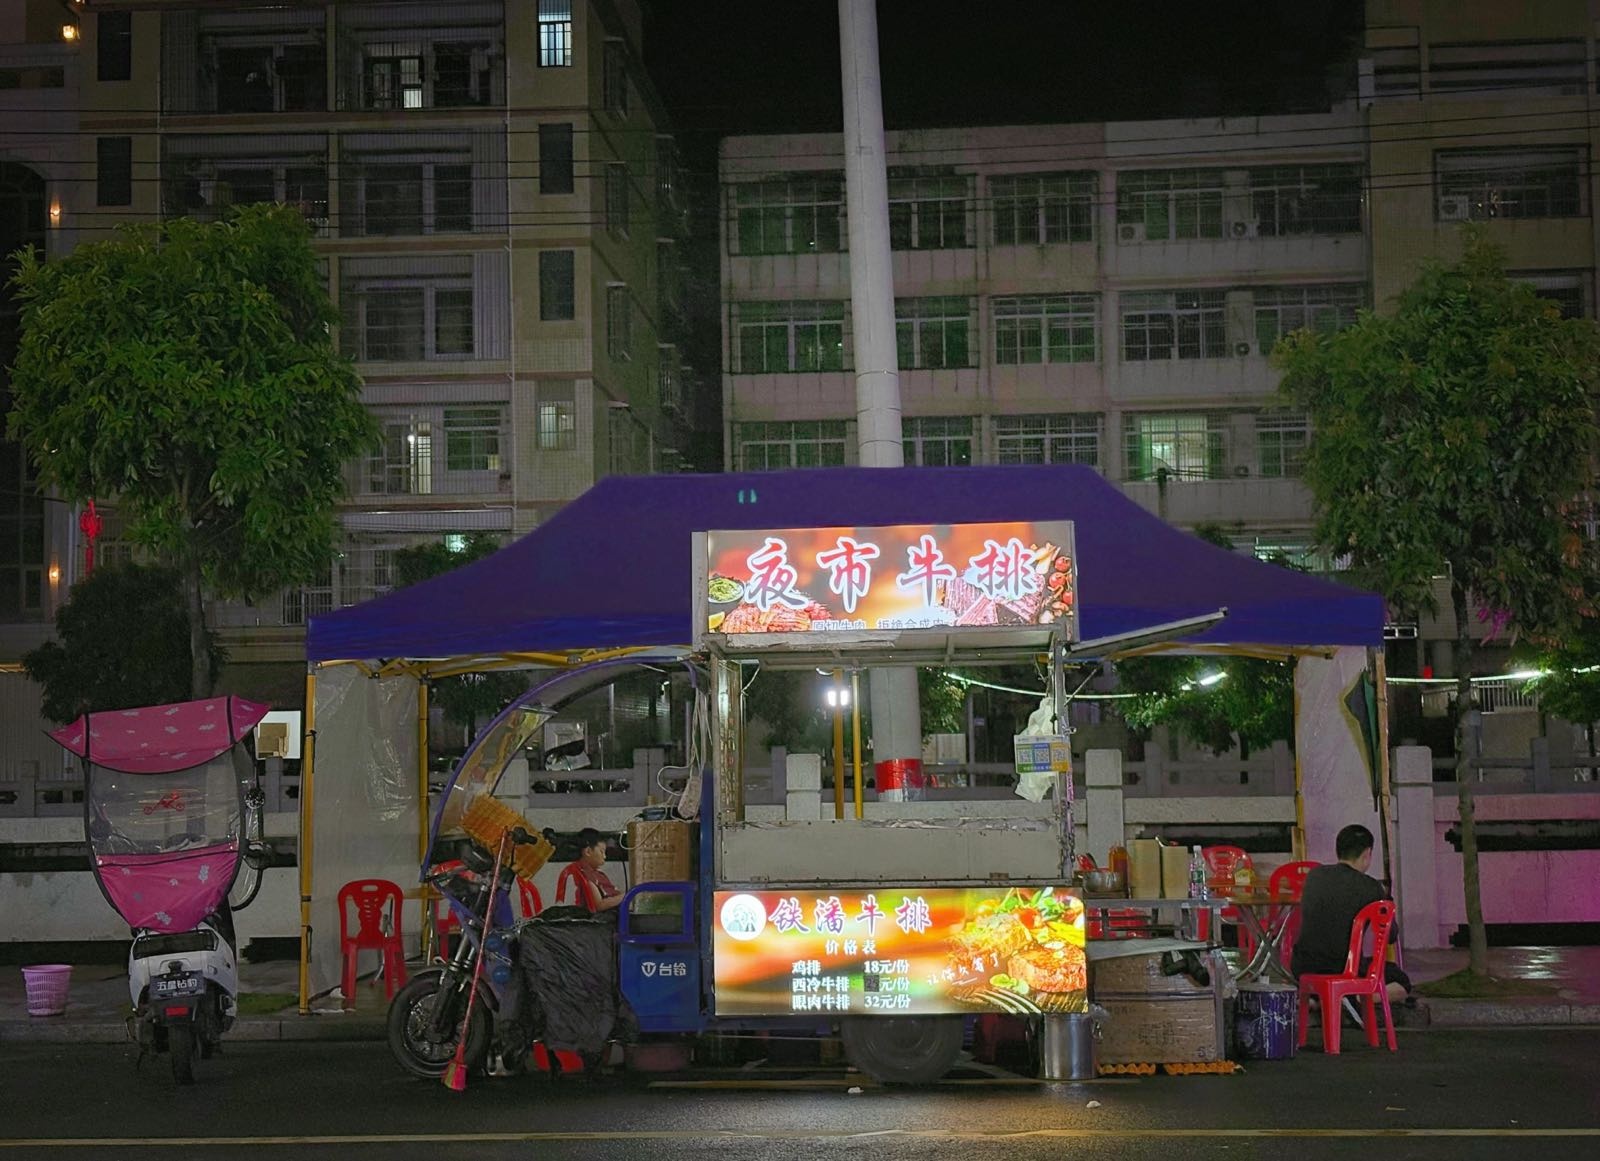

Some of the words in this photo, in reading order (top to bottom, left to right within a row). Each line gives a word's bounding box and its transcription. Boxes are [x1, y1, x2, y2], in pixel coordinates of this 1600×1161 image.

[745, 535, 1038, 611] 夜市牛排
[813, 619, 866, 630] 原切牛肉
[769, 896, 932, 935] 铁潘牛排
[825, 939, 877, 955] 价格表
[659, 962, 686, 976] 台铃
[792, 960, 821, 975] 鸡排
[864, 960, 910, 974] 18元/份
[792, 976, 850, 992] 西冷牛排
[792, 993, 850, 1010] 眼肉牛排
[864, 994, 911, 1009] 32元/份
